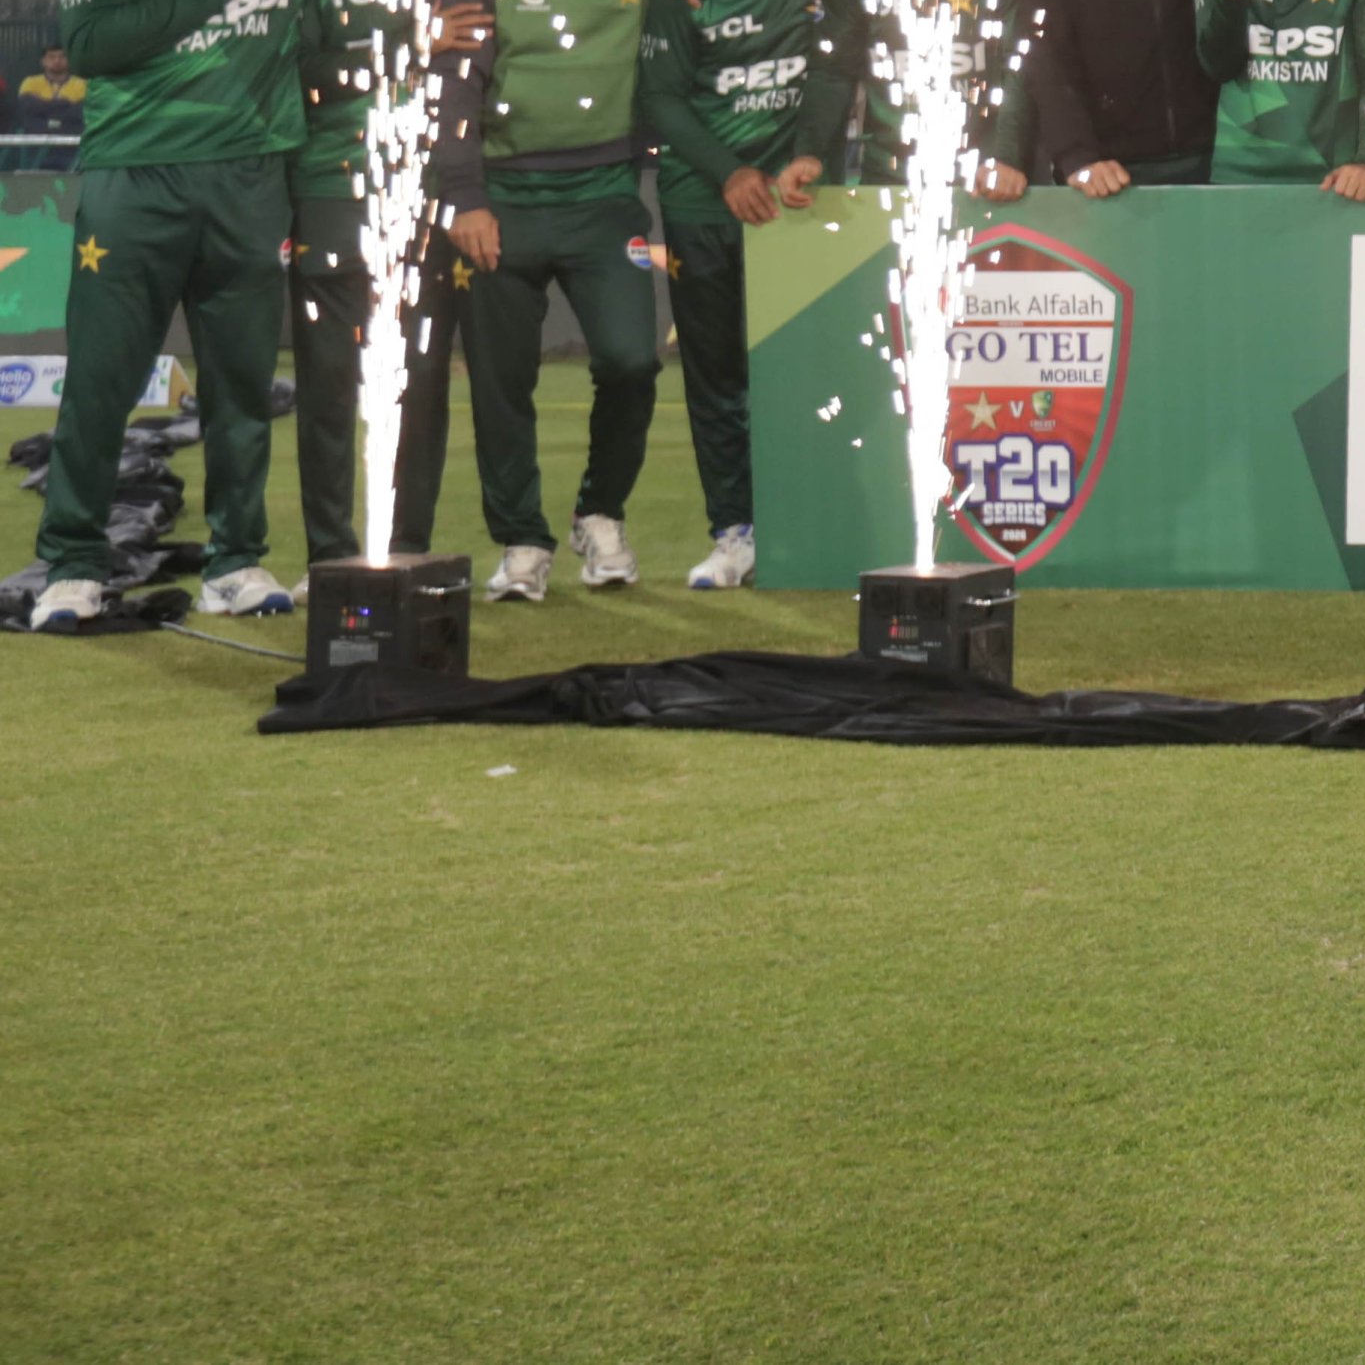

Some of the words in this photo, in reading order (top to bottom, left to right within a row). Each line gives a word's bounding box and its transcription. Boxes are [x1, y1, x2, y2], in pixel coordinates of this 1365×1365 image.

[703, 13, 763, 42] TCL
[1248, 24, 1344, 56] EPSI
[717, 55, 808, 95] PEP
[966, 294, 1020, 315] Bank
[1027, 293, 1104, 315] Alfalah
[946, 331, 1007, 363] GO
[1019, 331, 1104, 363] TEL
[1040, 369, 1103, 383] MOBILE
[957, 435, 1071, 504] T20
[982, 502, 1046, 526] SERIES
